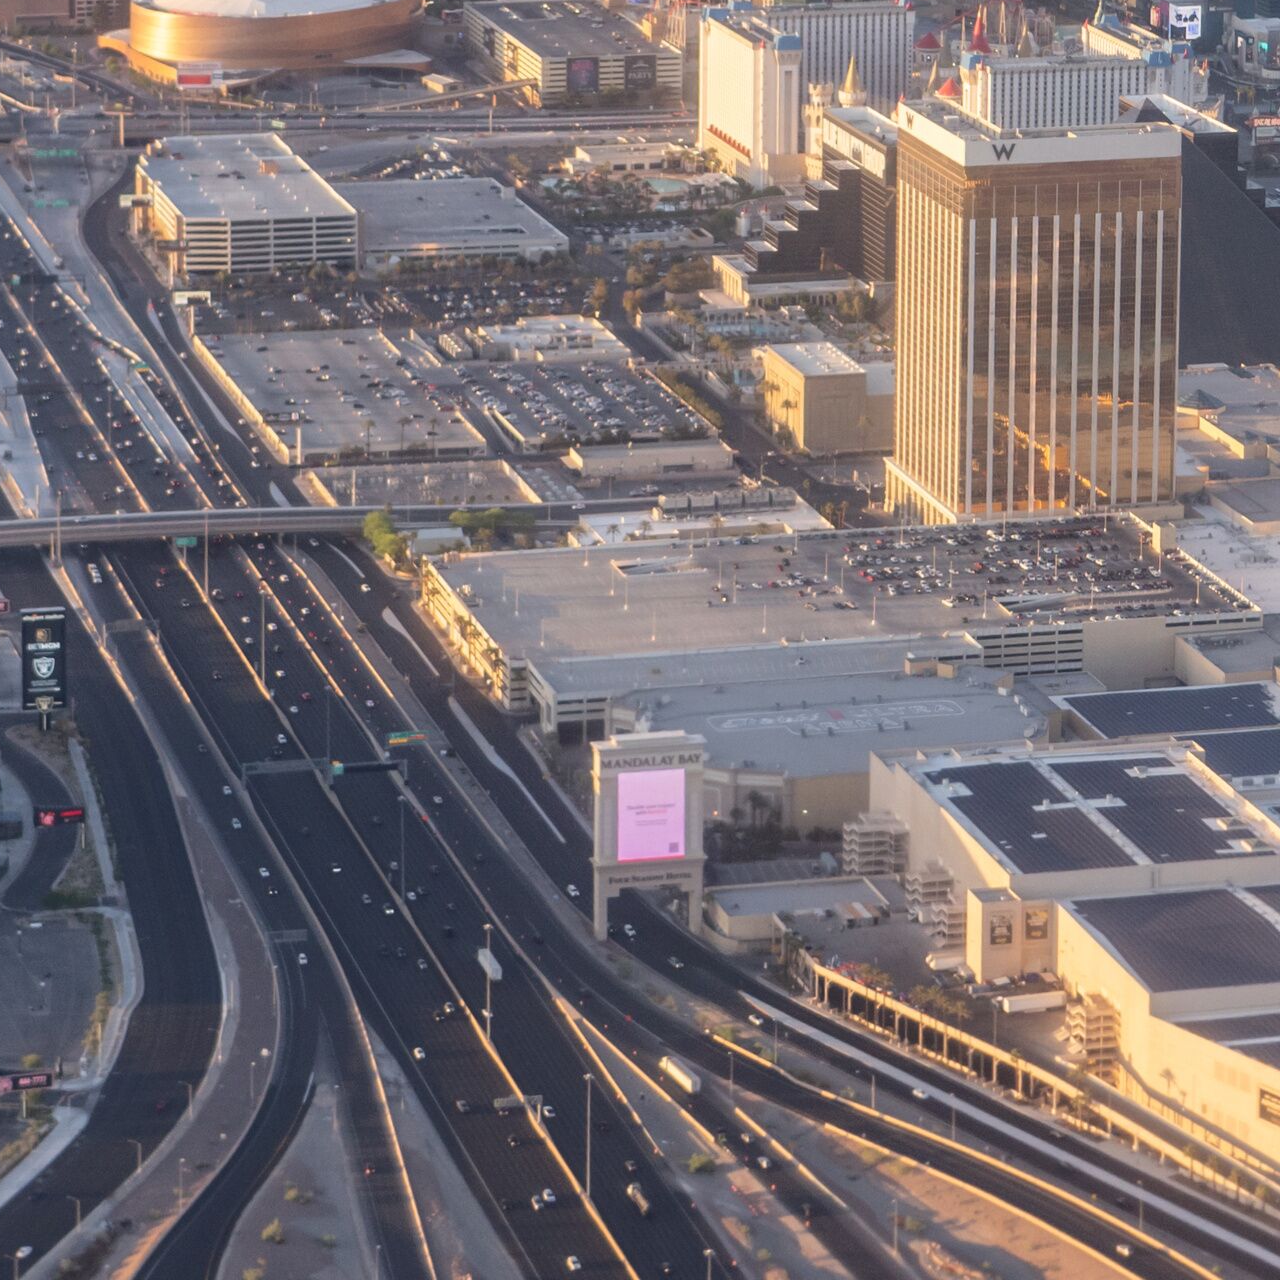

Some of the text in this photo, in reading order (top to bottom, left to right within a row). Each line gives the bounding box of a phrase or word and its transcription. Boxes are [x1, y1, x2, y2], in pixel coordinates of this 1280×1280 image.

[906, 111, 914, 129] W
[992, 143, 1016, 161] W
[602, 753, 702, 768] MANDALAY BAY
